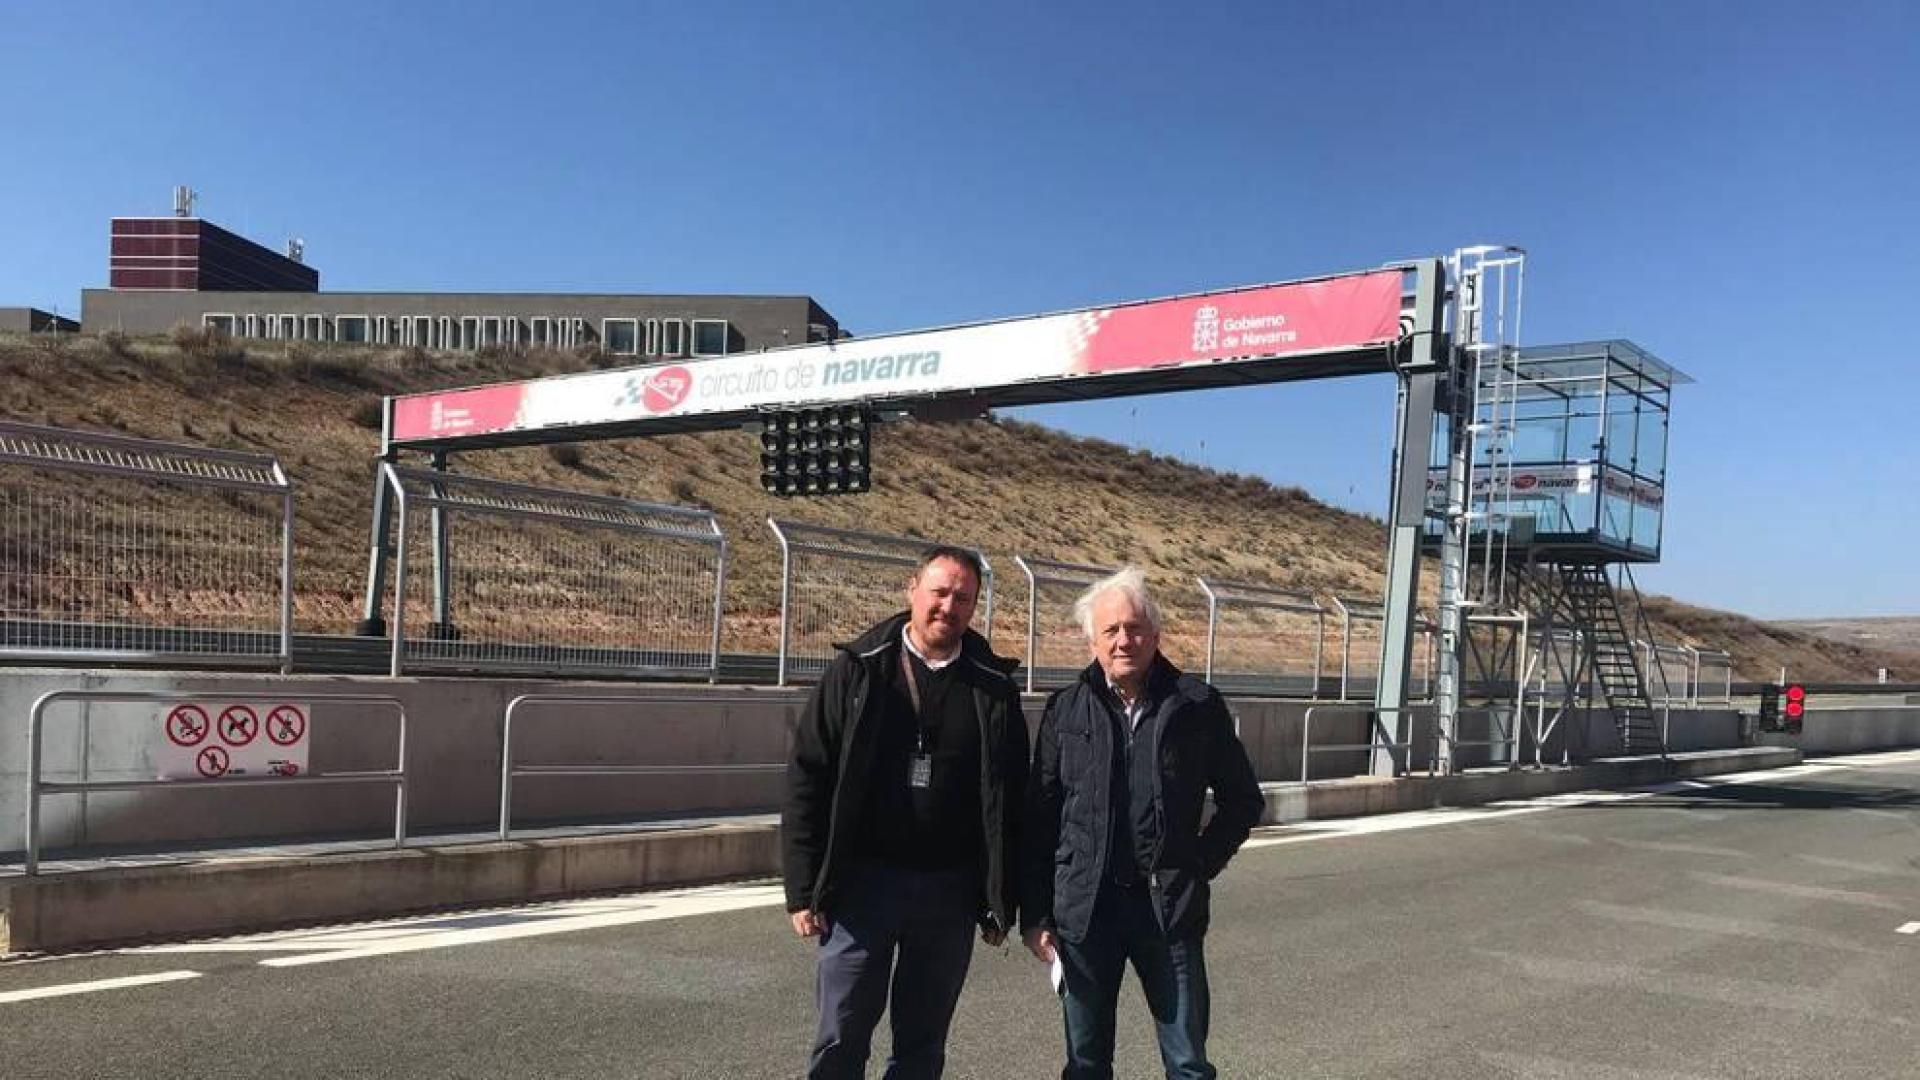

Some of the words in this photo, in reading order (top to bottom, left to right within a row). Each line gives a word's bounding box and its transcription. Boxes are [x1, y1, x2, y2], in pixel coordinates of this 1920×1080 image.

[1223, 315, 1285, 331] Gobierno
[1223, 335, 1239, 347] de
[1241, 331, 1296, 346] Navarra
[701, 362, 778, 398] circuito
[784, 361, 816, 388] de
[823, 351, 941, 385] navarra
